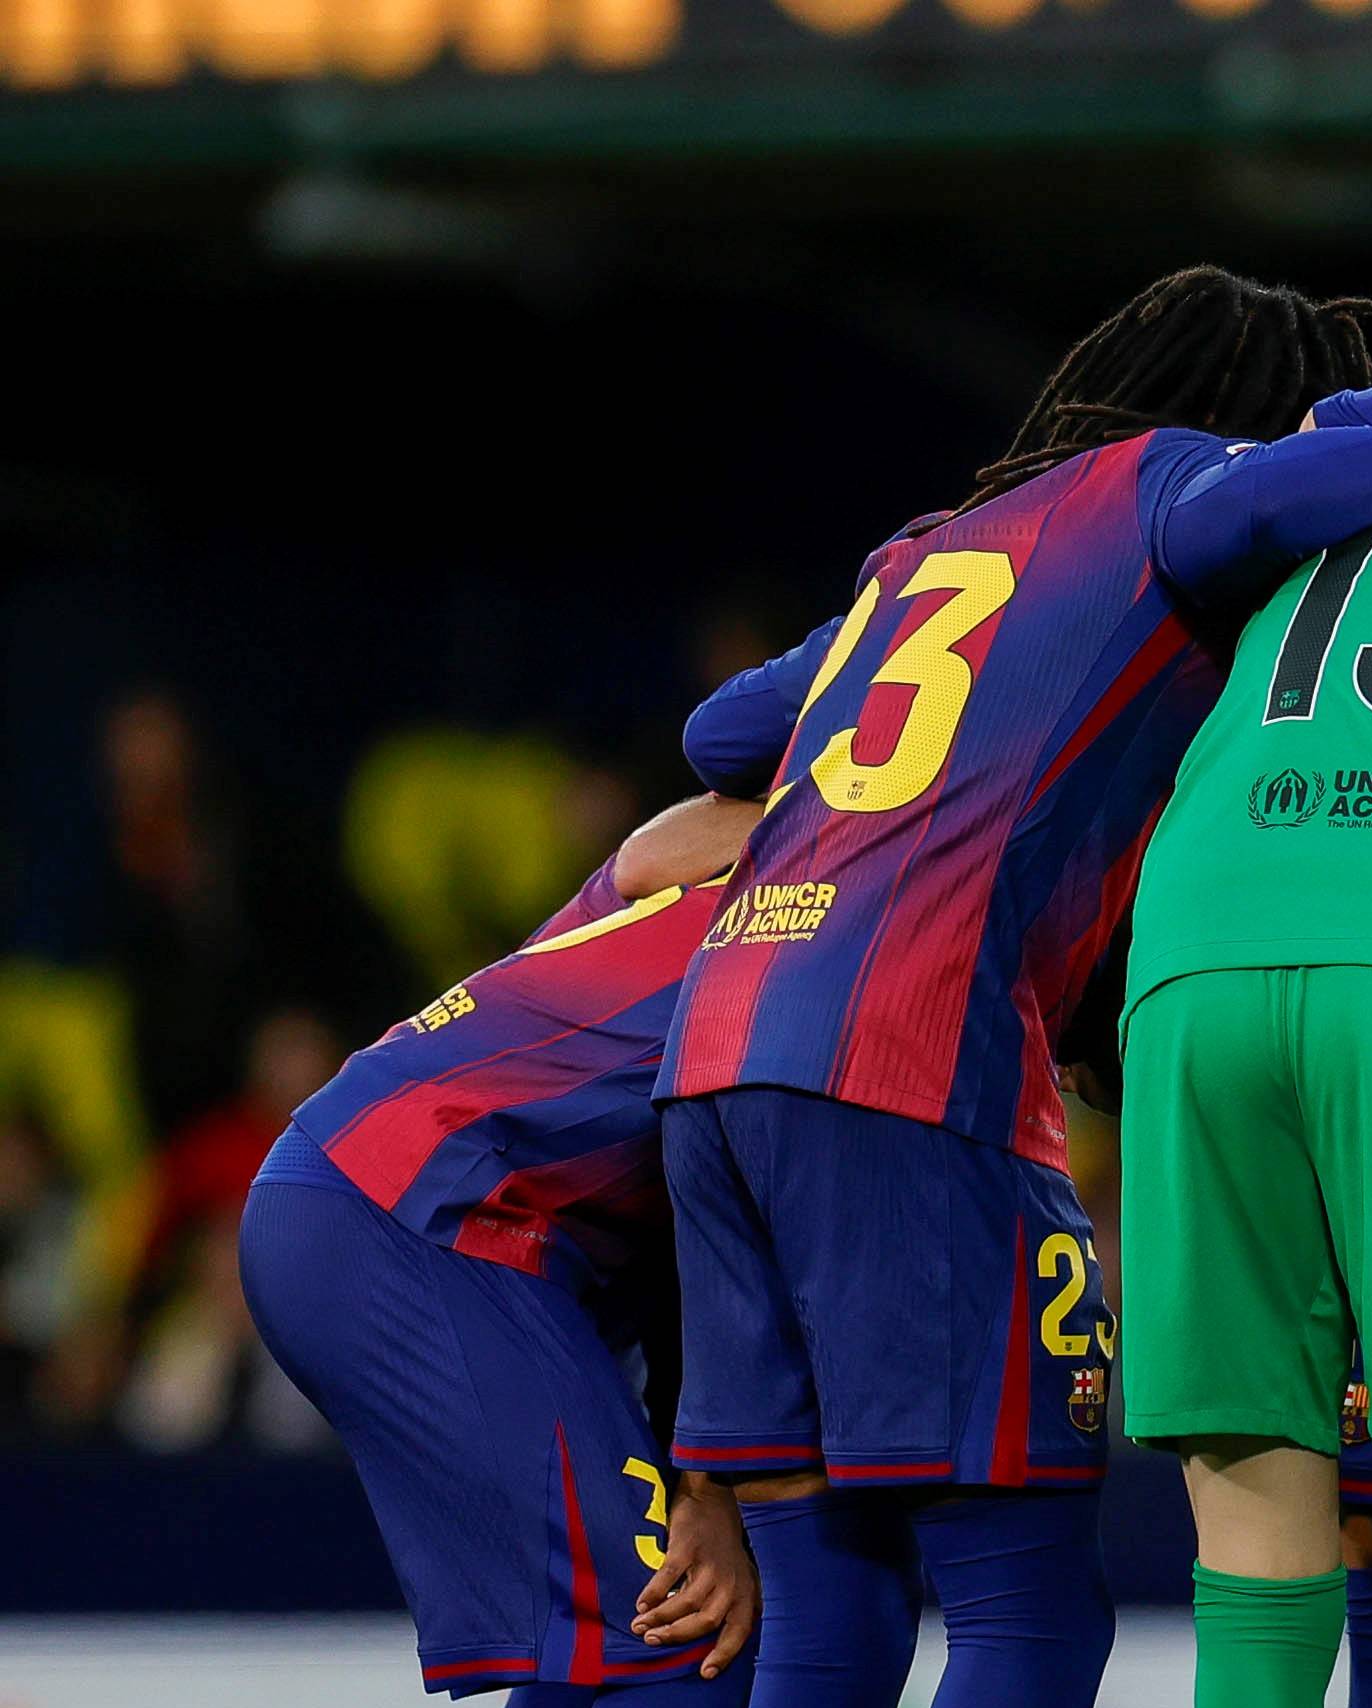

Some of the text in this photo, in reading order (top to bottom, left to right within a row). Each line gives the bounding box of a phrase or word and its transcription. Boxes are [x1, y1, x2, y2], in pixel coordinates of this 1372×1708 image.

[1328, 819, 1345, 828] The
[1346, 819, 1363, 829] UN
[753, 881, 838, 911] UNHCR
[743, 907, 827, 935] ACNUR
